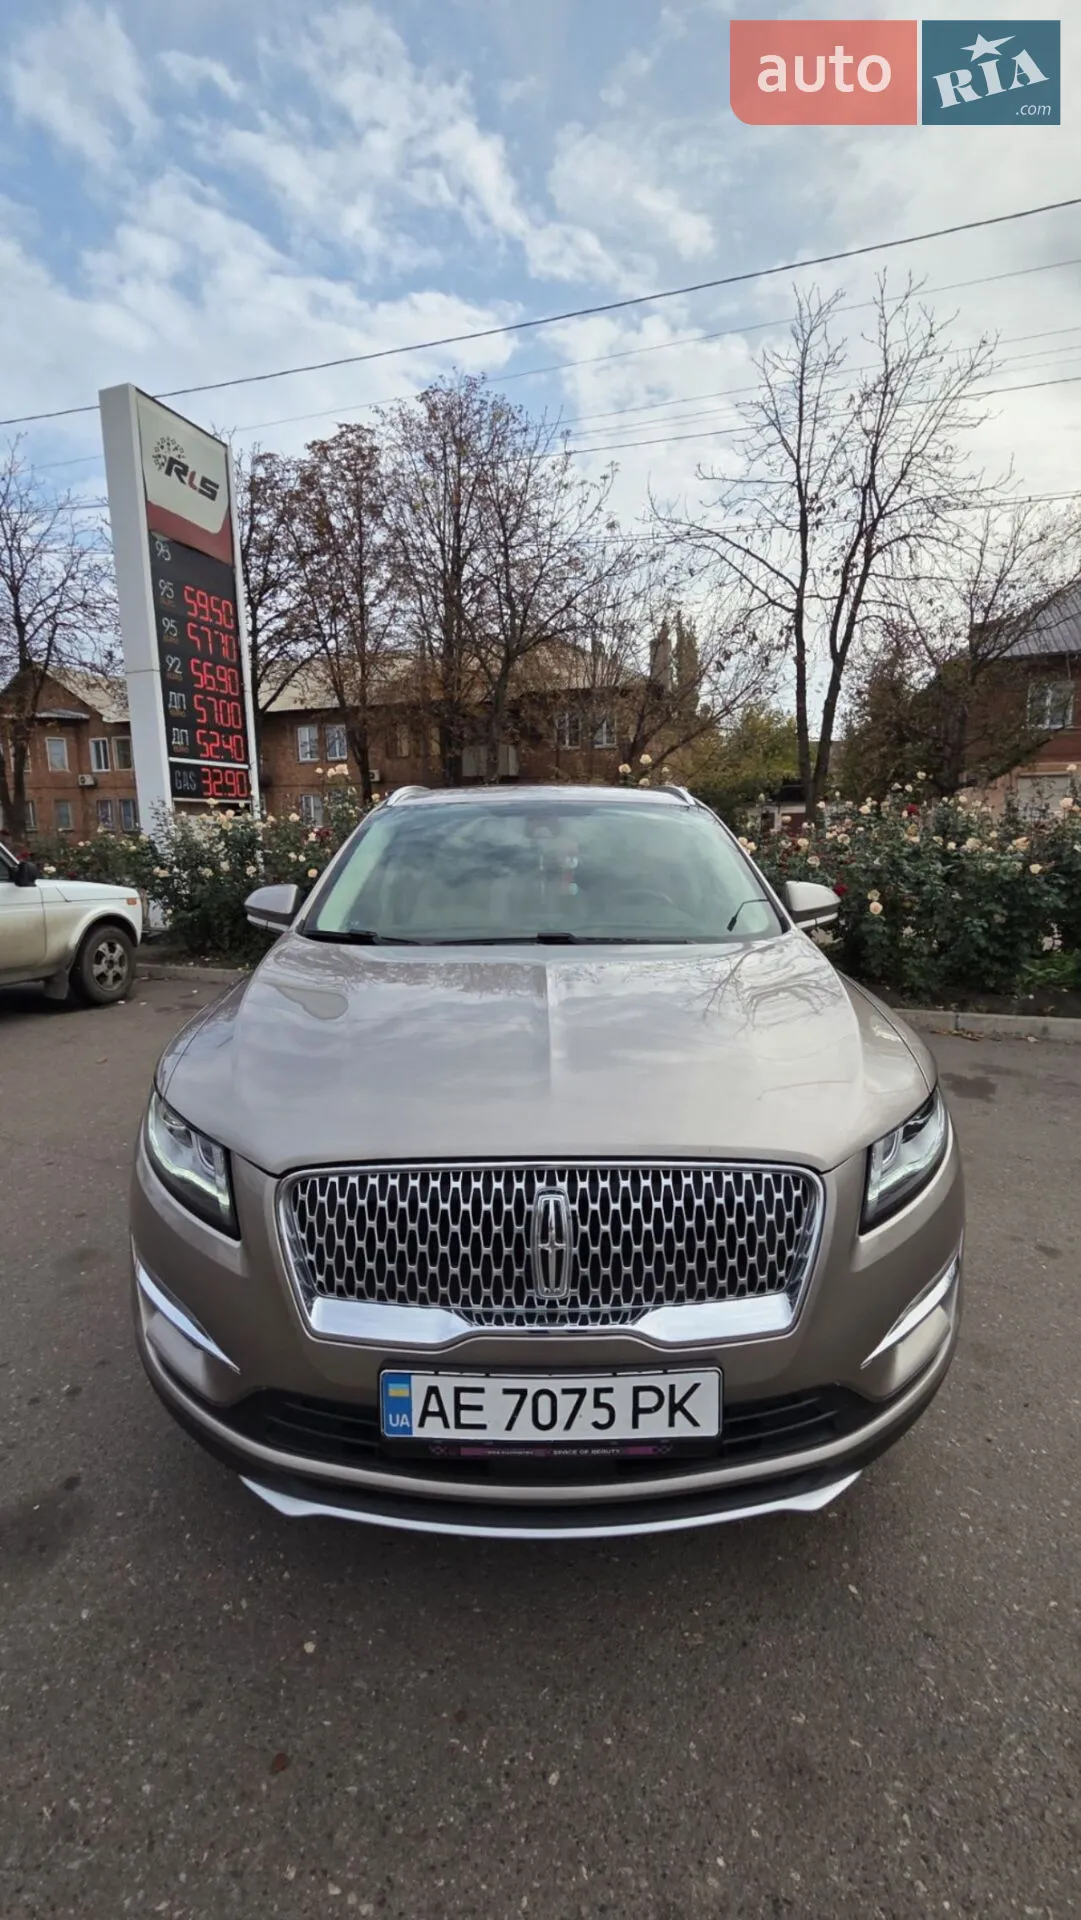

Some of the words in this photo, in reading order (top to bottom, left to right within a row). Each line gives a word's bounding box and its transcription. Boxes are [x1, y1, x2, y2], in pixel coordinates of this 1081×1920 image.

[165, 456, 219, 501] RLS
[159, 579, 174, 599] 95
[162, 617, 178, 637] 95
[166, 655, 182, 674] 92
[174, 770, 197, 791] GAS
[418, 1385, 487, 1430] AE
[502, 1387, 616, 1431] 7075
[631, 1382, 702, 1430] PK
[389, 1414, 411, 1428] UA
